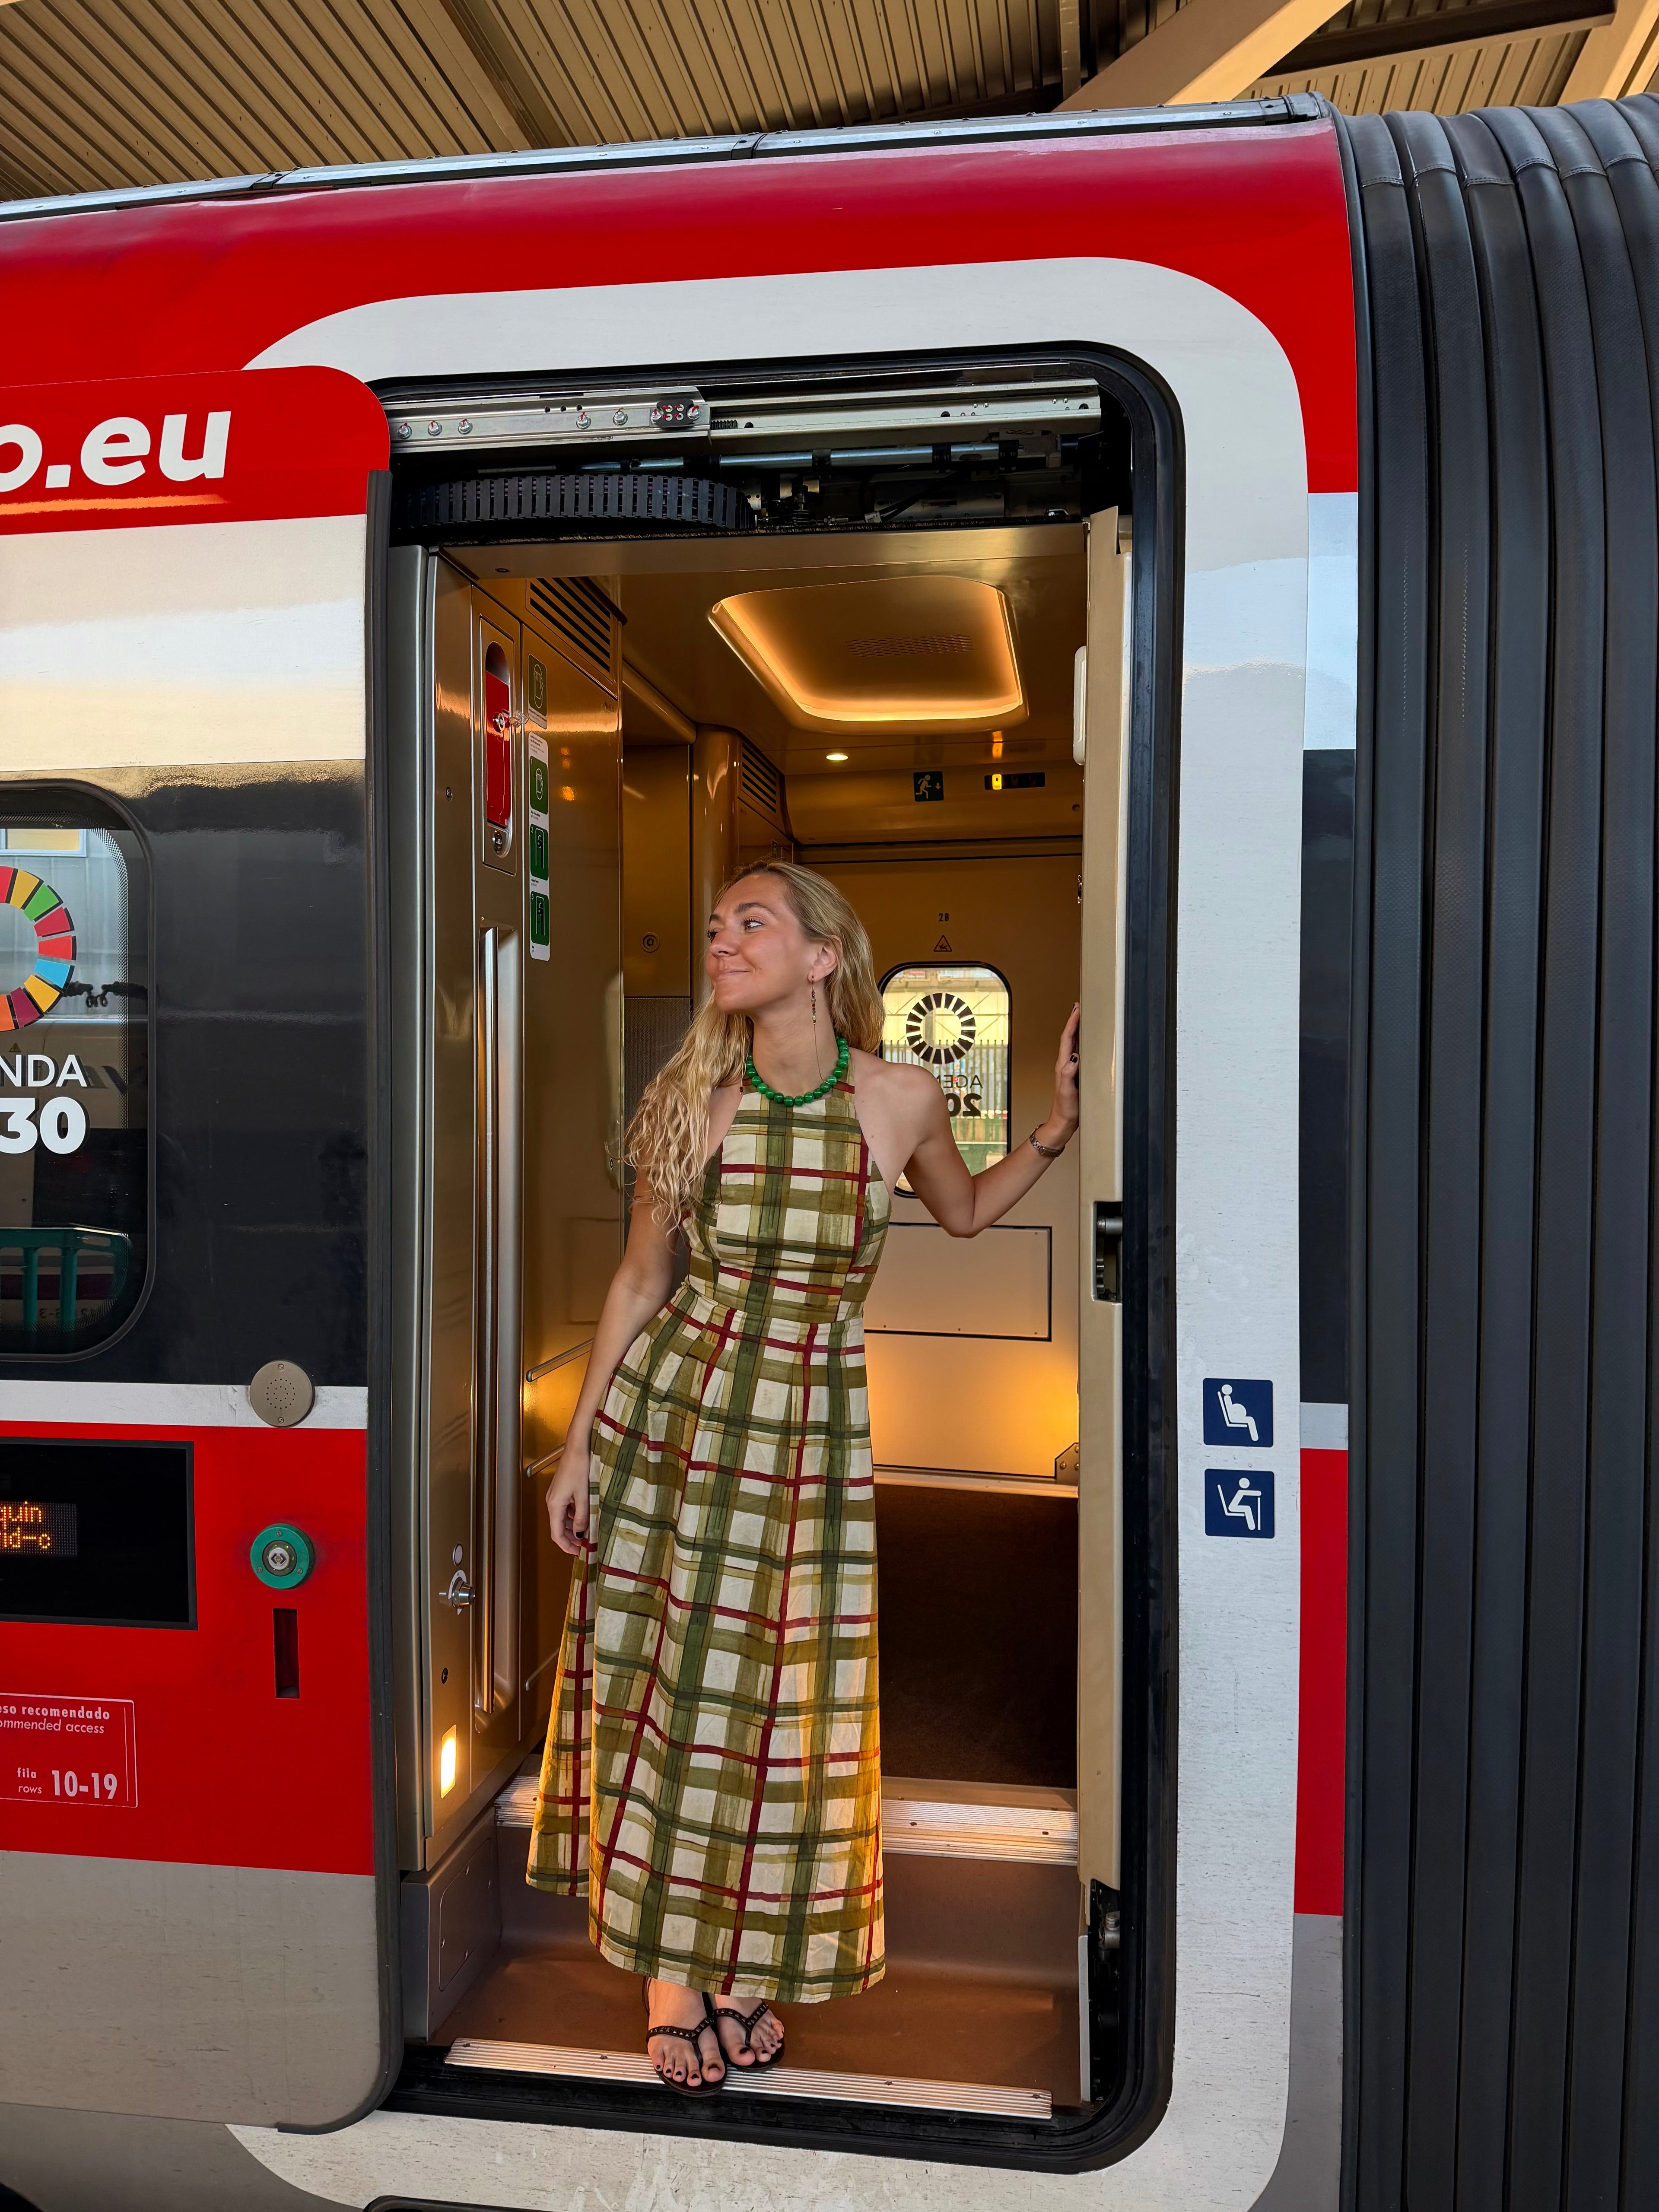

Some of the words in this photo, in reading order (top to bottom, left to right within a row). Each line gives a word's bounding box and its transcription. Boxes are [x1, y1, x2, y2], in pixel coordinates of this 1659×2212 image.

[0, 1705, 16, 1714] so
[22, 1705, 110, 1720] recomendado
[66, 1724, 104, 1734] access
[17, 1767, 37, 1779] fila
[18, 1785, 42, 1794] rows
[51, 1770, 118, 1800] 10-19
